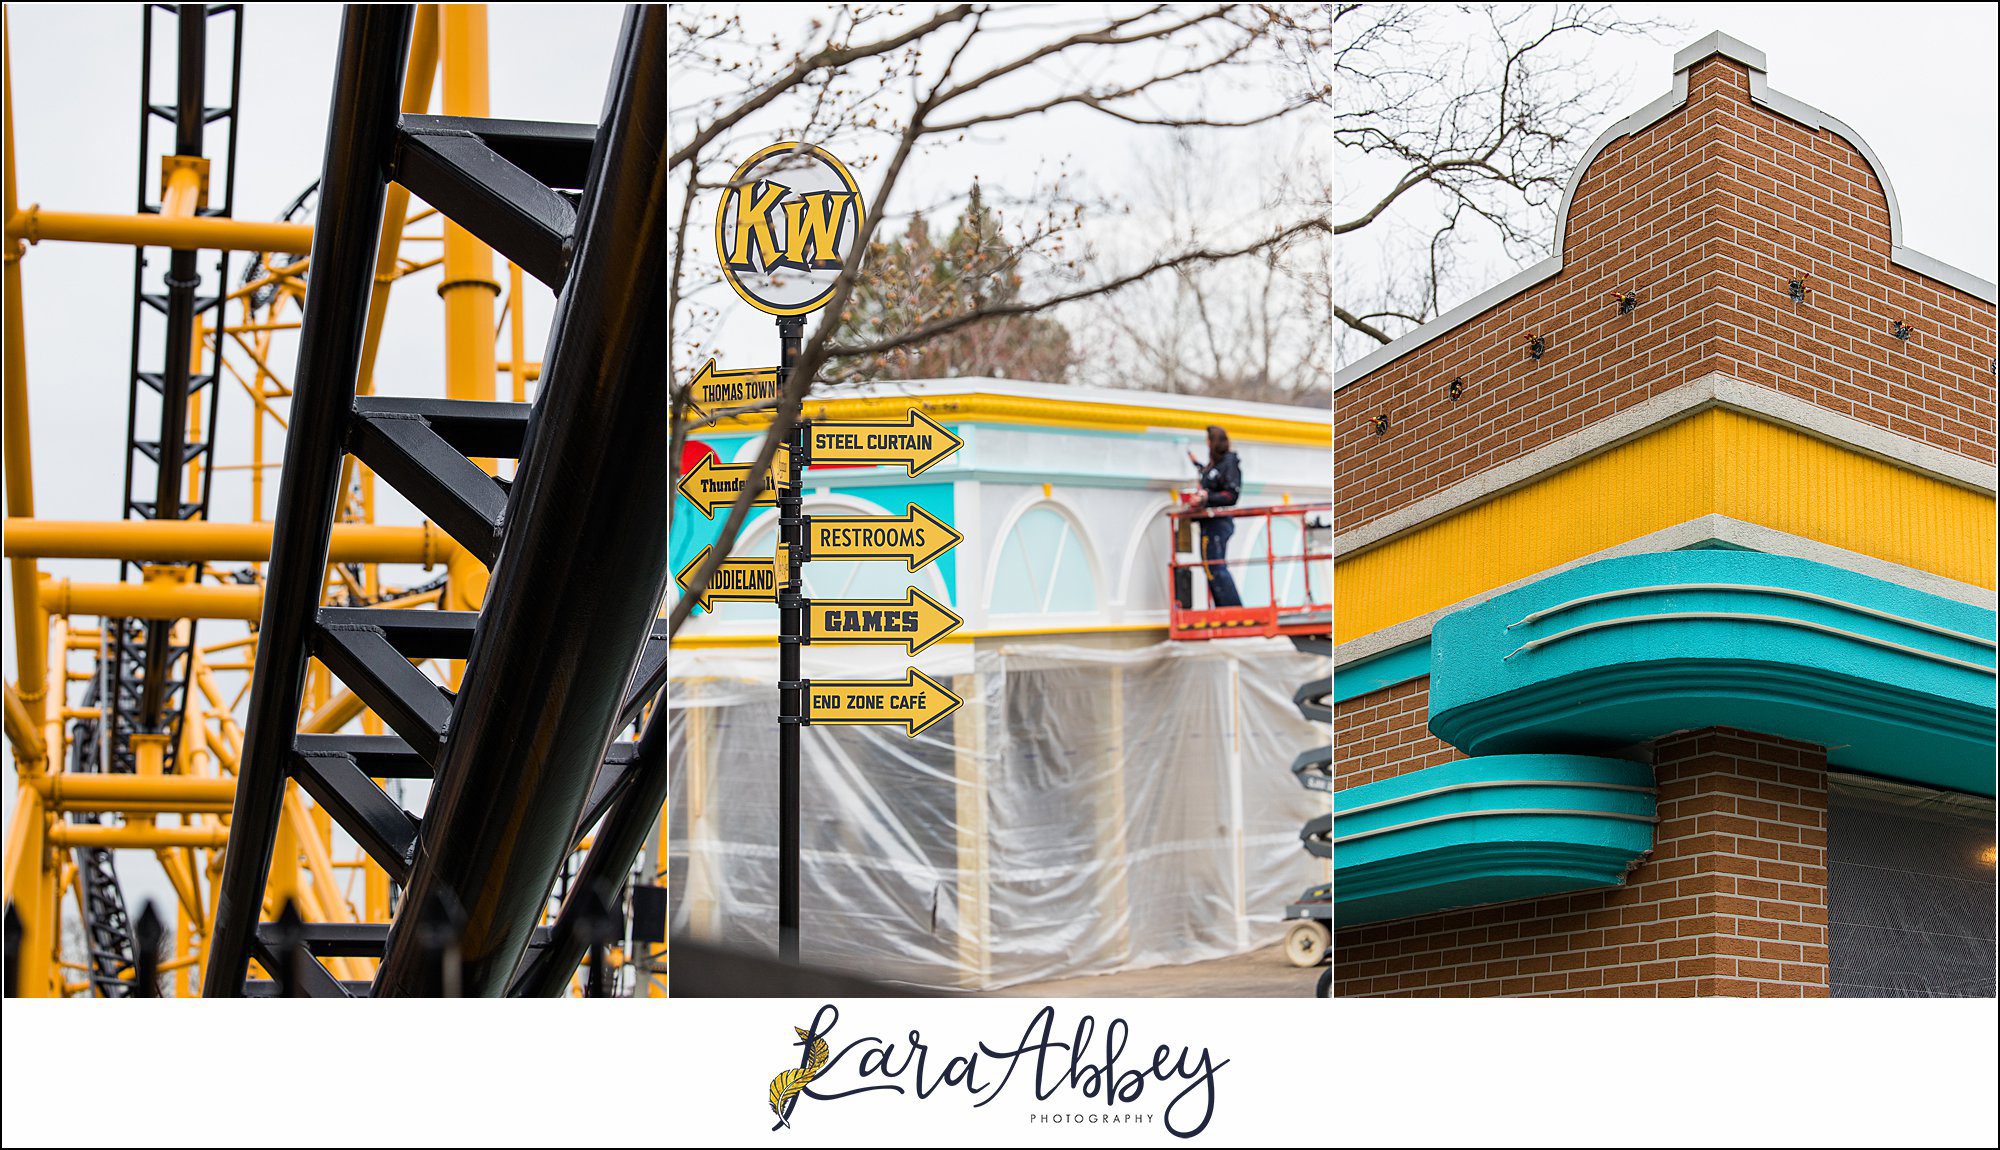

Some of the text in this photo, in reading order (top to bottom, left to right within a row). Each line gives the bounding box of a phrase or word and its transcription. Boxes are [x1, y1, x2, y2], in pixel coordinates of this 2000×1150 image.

[725, 179, 858, 276] KW
[702, 380, 776, 402] THOMAS TOWN
[815, 433, 933, 451] STEEL CURTAIN
[700, 476, 776, 493] Thundelt
[820, 527, 926, 548] RESTROOMS
[704, 569, 774, 590] IDDIELAND
[824, 610, 919, 633] GAMES
[813, 691, 927, 709] END ZONE CAFÉ
